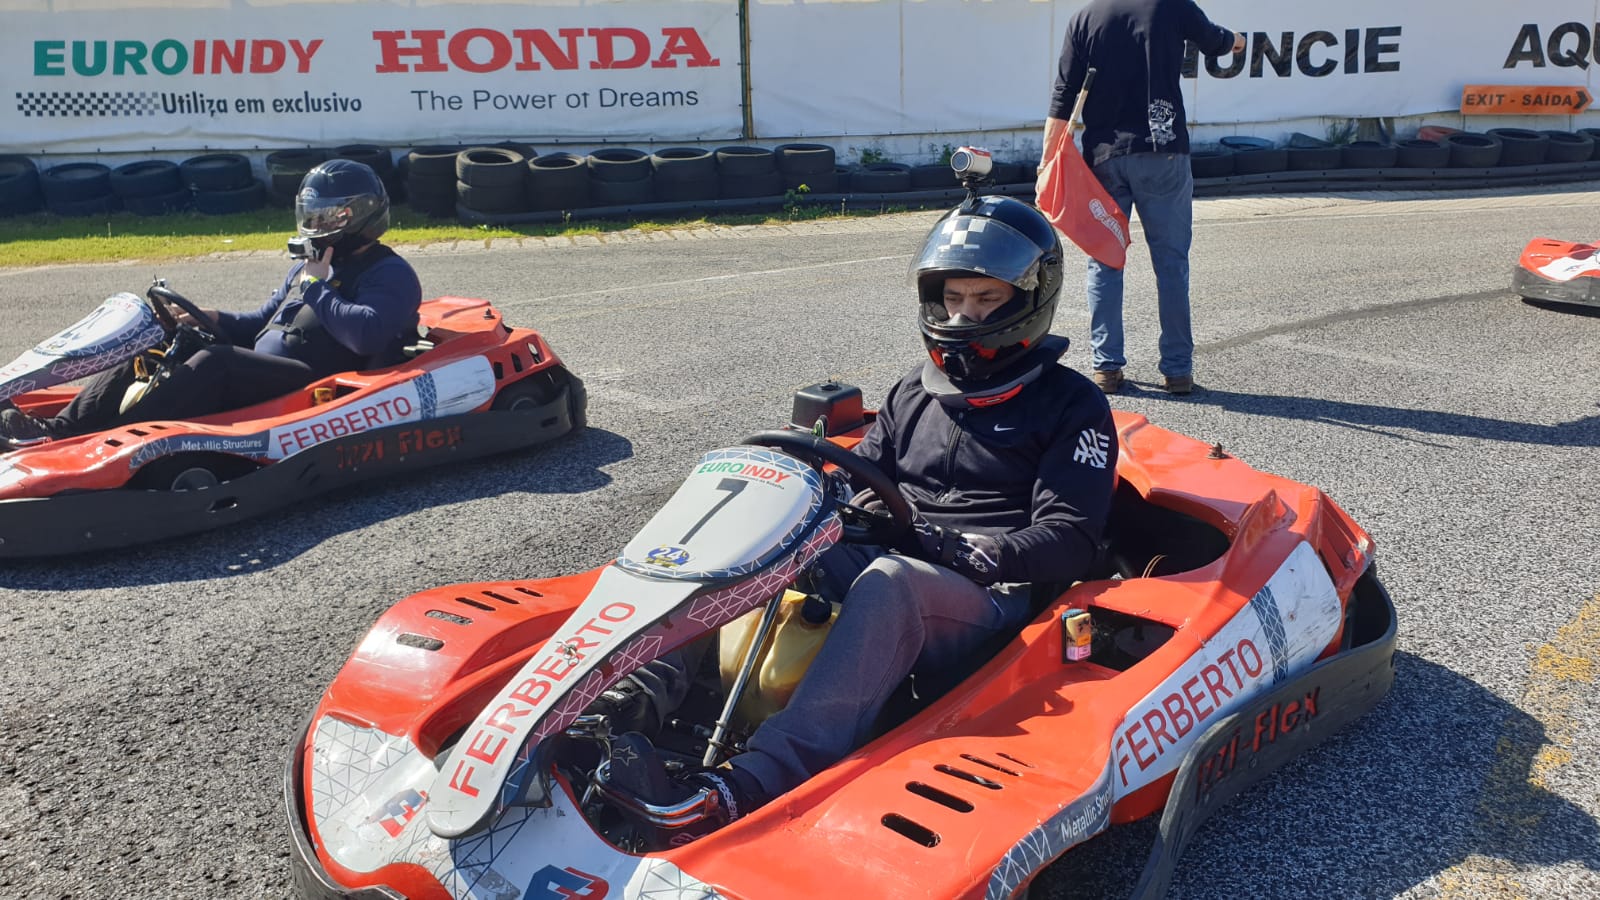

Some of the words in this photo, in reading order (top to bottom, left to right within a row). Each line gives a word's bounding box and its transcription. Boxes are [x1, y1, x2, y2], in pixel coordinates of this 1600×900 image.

[33, 39, 324, 76] EUROINDY
[372, 27, 721, 73] HONDA
[1503, 22, 1600, 71] AQ
[161, 91, 228, 116] Utiliza
[235, 95, 265, 114] em
[272, 91, 362, 113] exclusivo
[411, 90, 463, 111] The
[473, 89, 557, 110] Power
[565, 92, 591, 109] of
[599, 87, 699, 108] Dreams
[1465, 94, 1505, 106] EXIT
[1522, 92, 1573, 106] SAÍDA
[181, 438, 221, 450] Metallic
[222, 438, 262, 449] Structures
[278, 396, 413, 455] FERBERTO
[697, 462, 791, 483] EUROINDY
[678, 478, 749, 545] 7
[652, 546, 684, 562] 24
[448, 602, 636, 798] FERBERTO
[1115, 639, 1263, 787] FERBERTO
[1060, 805, 1097, 842] Metallic
